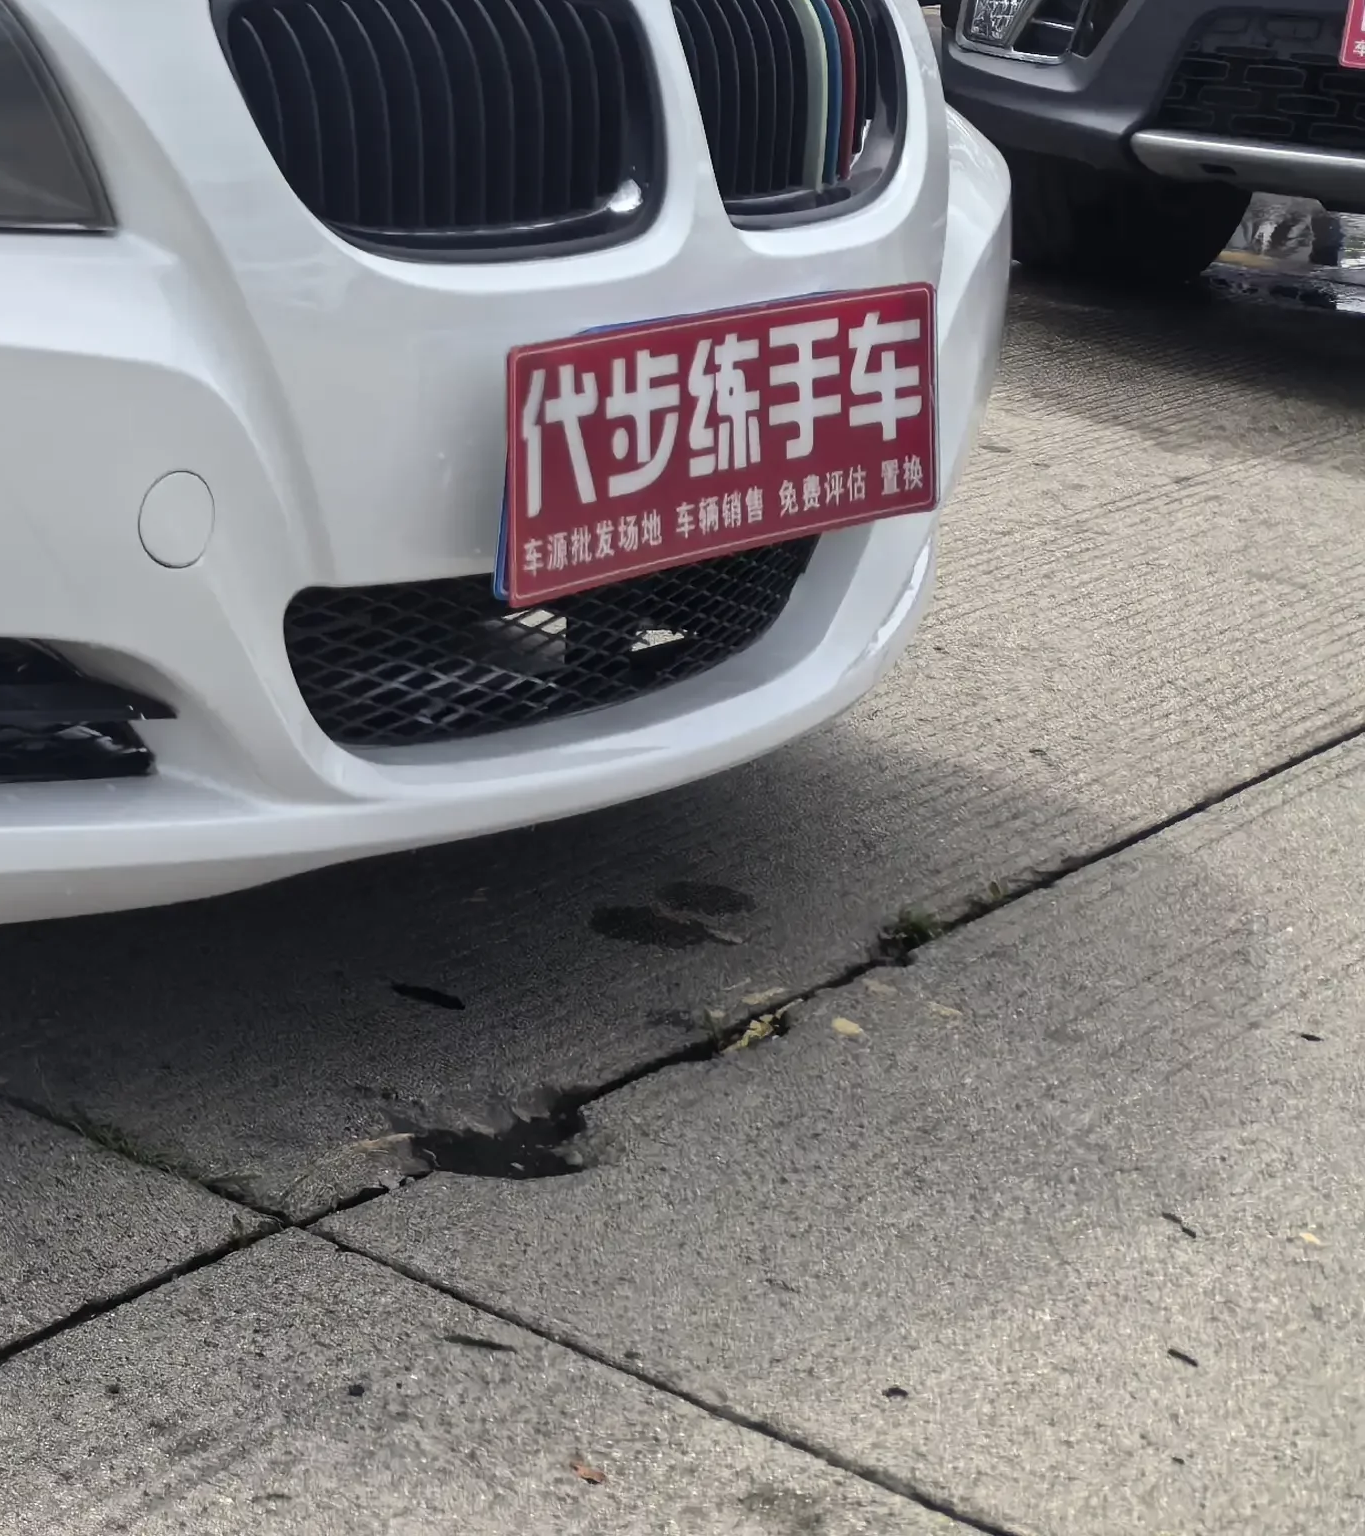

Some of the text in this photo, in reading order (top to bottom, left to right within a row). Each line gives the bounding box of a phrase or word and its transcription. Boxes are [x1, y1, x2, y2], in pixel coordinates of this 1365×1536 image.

[522, 312, 922, 517] 代步练手车
[523, 454, 923, 577] 车源批发场地 车辆销售 免费评估 置换
